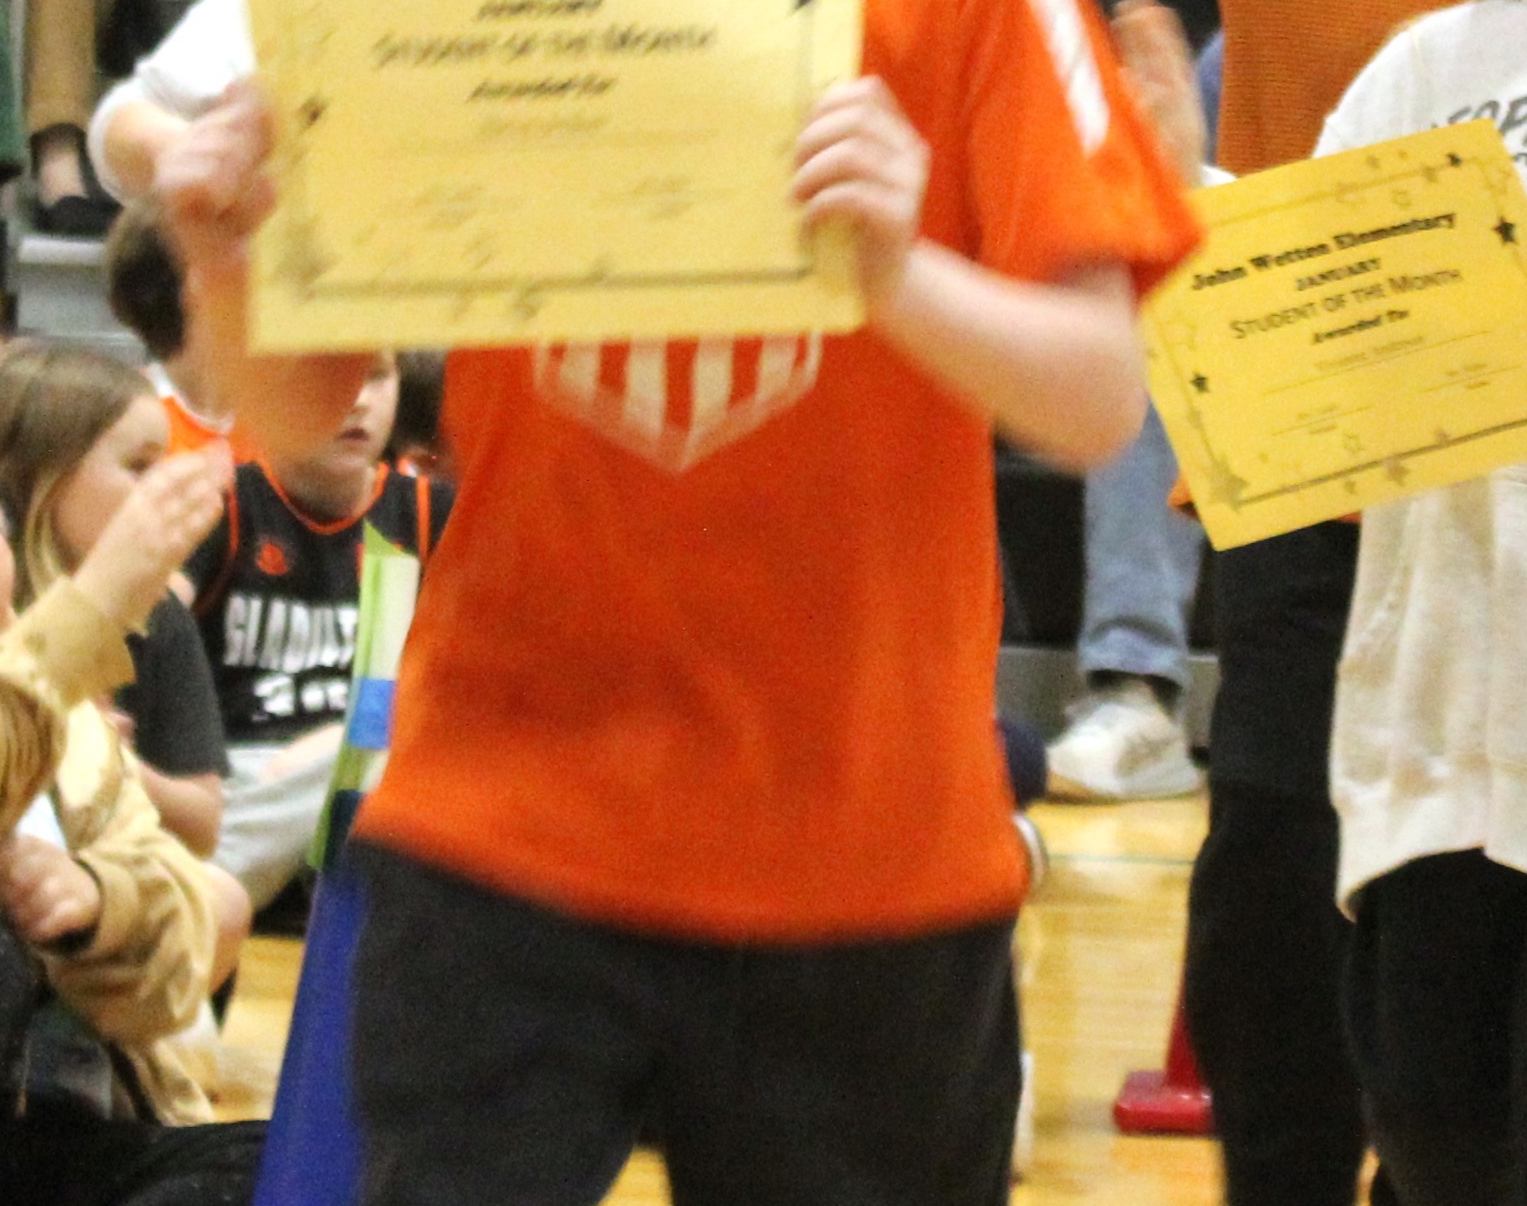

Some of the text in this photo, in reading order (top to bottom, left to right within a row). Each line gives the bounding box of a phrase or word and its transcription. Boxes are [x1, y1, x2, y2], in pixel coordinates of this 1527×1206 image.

[1191, 212, 1457, 291] John Wetten Elementary
[1296, 258, 1381, 291] JANUARY
